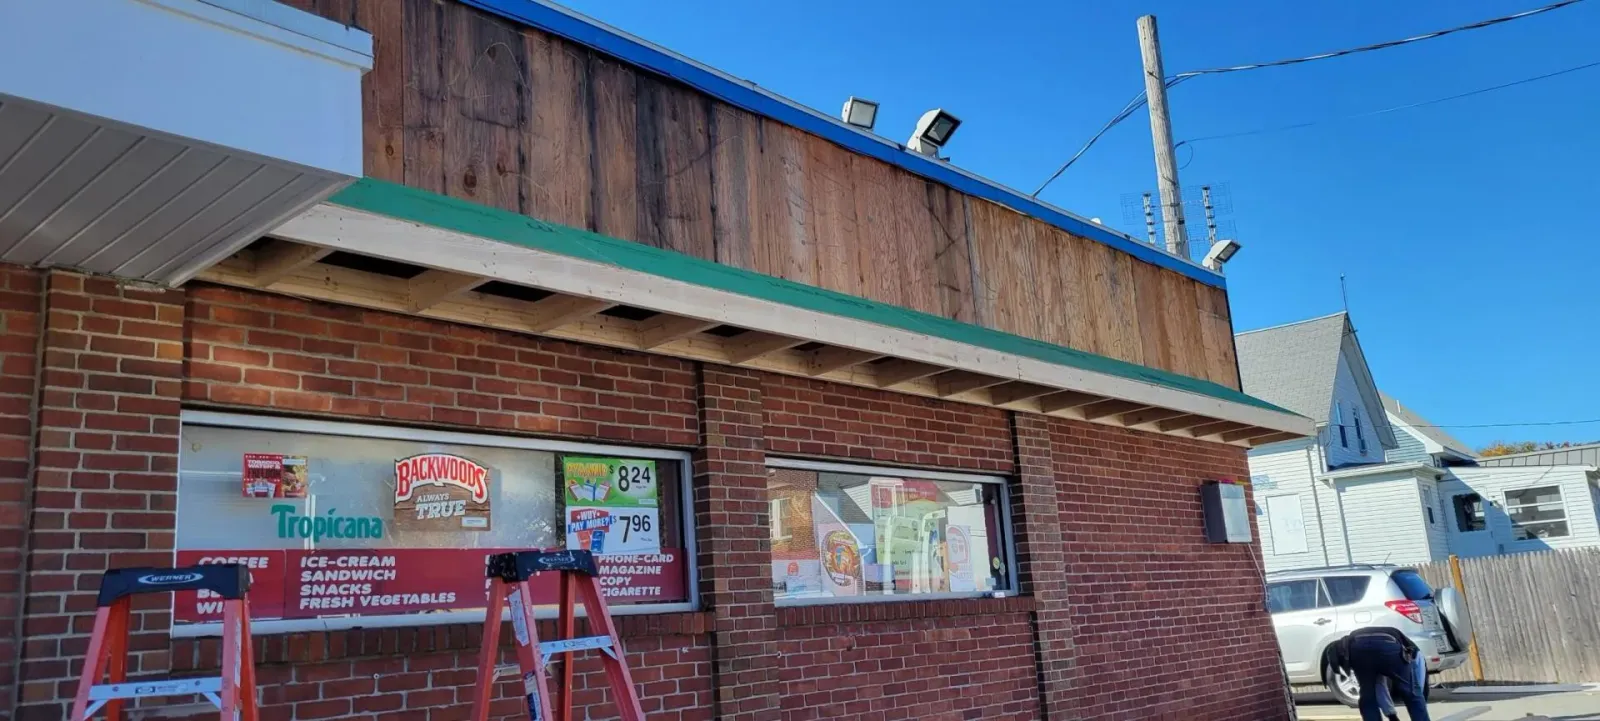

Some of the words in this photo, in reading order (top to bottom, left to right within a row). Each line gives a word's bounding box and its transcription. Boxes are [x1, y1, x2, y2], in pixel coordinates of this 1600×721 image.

[395, 454, 487, 501] BACKWOODS
[417, 493, 450, 503] ALWAYS
[415, 500, 467, 520] TRUE
[271, 504, 383, 542] Tropicana
[571, 520, 585, 532] PAY
[300, 555, 396, 568] ICE-CREAM
[598, 553, 674, 563] PHONE-CARD
[300, 569, 397, 582] SANDWICH
[598, 565, 662, 574] MAGAZINE
[151, 574, 192, 582] WERNER
[599, 576, 632, 586] COPY
[300, 583, 372, 596] SNACKS
[600, 586, 661, 597] CIGARETTE
[299, 596, 355, 610] FRESH
[359, 592, 457, 607] VEGETABLES
